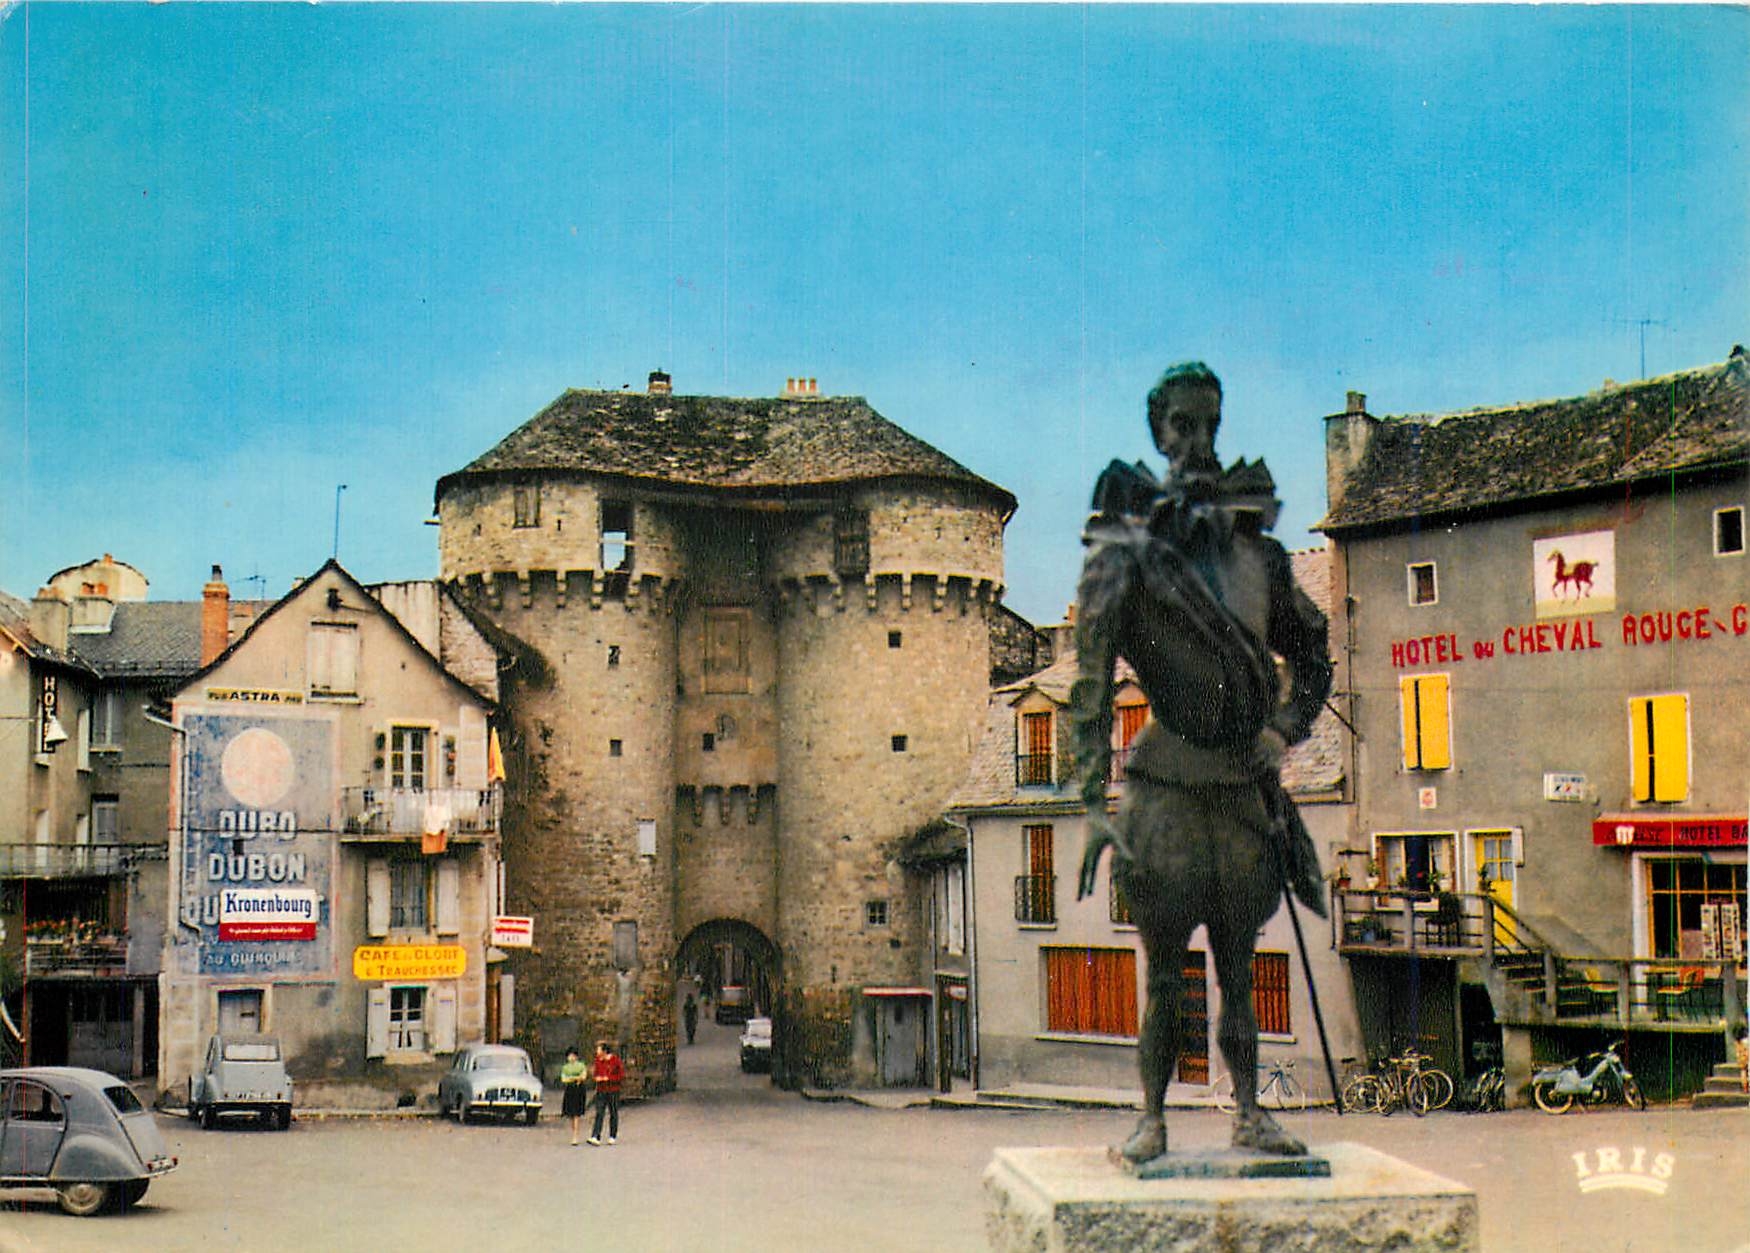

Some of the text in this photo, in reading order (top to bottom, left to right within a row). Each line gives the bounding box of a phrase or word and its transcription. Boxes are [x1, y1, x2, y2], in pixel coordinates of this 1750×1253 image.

[1391, 634, 1464, 667] HOTEL
[1503, 620, 1603, 655] CHEVAL
[1622, 608, 1711, 646] ROUGE
[230, 692, 280, 701] ASTRA
[219, 810, 297, 840] DUBO
[1680, 825, 1721, 841] HOTEL
[208, 853, 306, 881] DUBON
[225, 893, 312, 919] Kronenbourg
